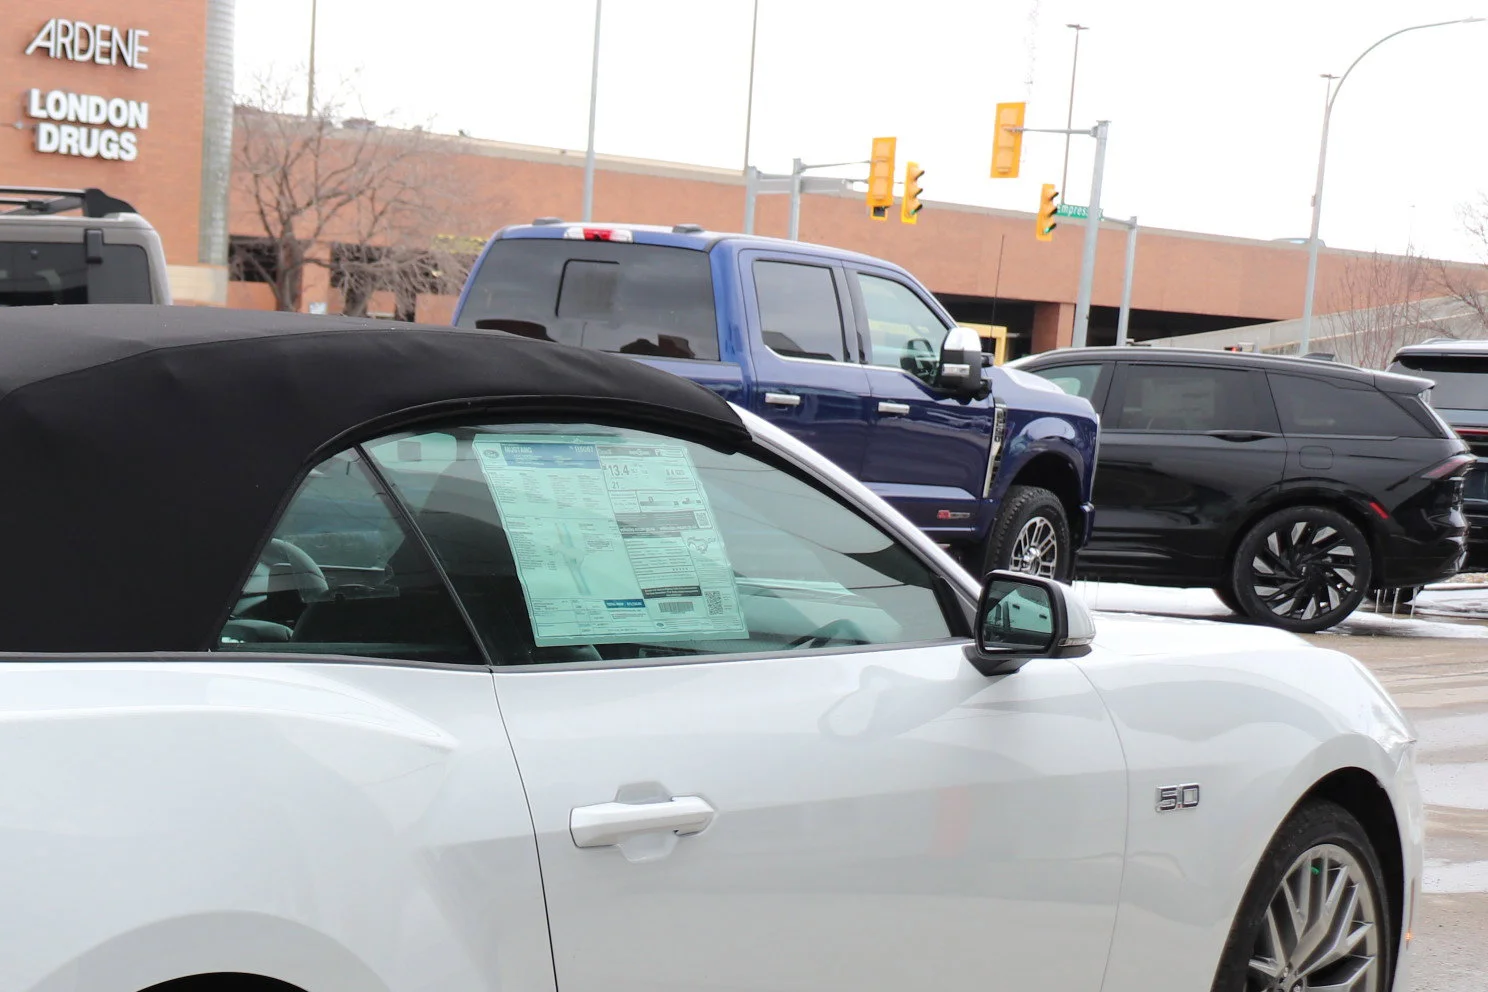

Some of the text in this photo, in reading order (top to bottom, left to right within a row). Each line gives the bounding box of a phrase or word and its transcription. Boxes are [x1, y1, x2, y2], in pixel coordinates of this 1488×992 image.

[25, 18, 149, 69] ARDENE
[29, 88, 149, 129] LONDON
[38, 122, 138, 161] DRUGS
[608, 464, 630, 477] 13.4
